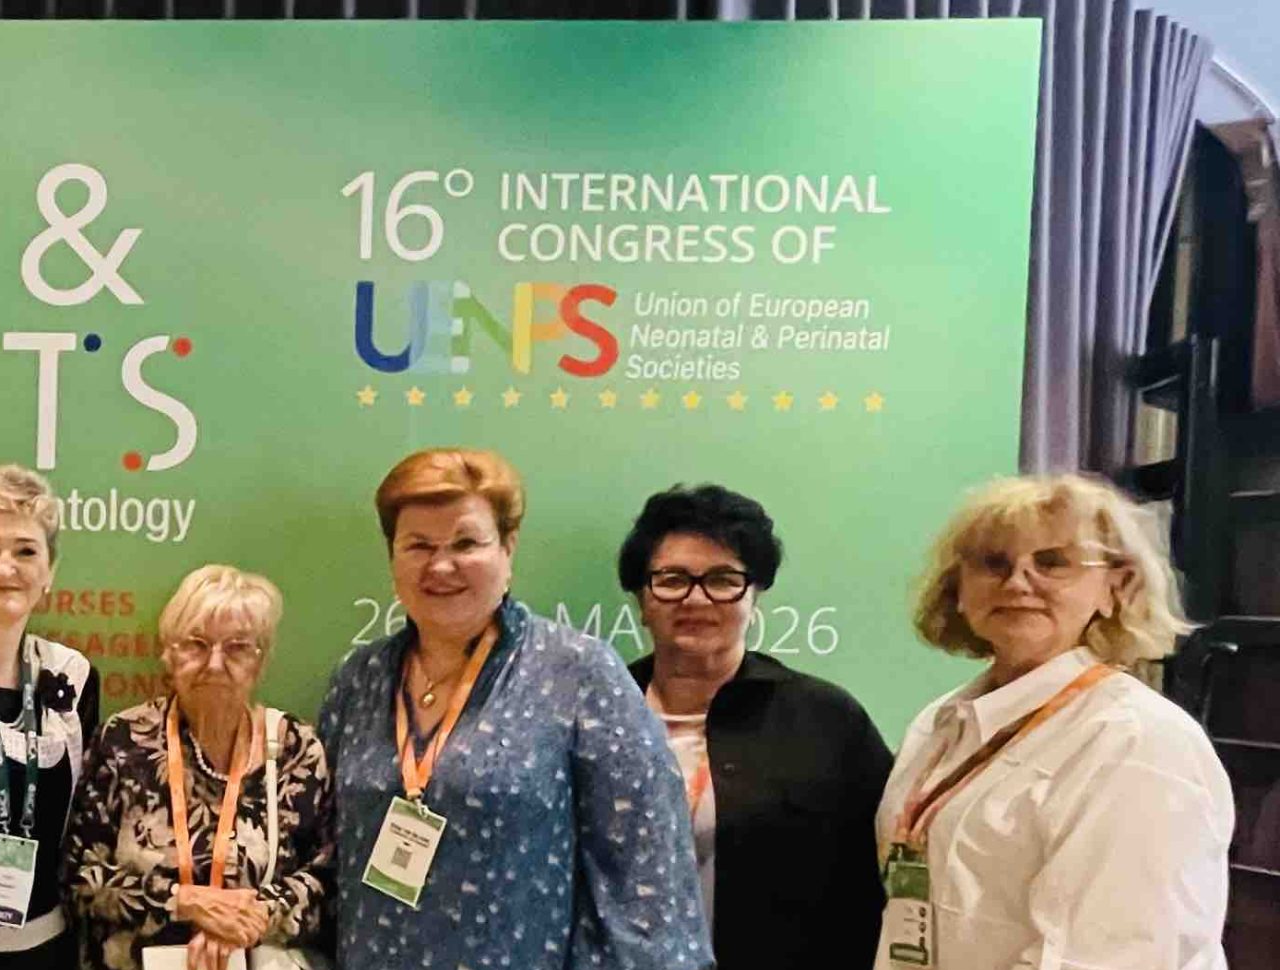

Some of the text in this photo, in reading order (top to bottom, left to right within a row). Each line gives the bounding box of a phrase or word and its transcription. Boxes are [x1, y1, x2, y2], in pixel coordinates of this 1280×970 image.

[501, 172, 891, 214] INTERNATIONAL
[22, 163, 145, 306] &
[498, 223, 837, 264] CONGRESS OF
[634, 292, 870, 322] Union of European
[354, 280, 620, 378] UENPS
[630, 324, 891, 350] Neonatal & Perinatal
[625, 354, 741, 380] Societies
[556, 601, 645, 651] MA
[747, 605, 839, 655] 026
